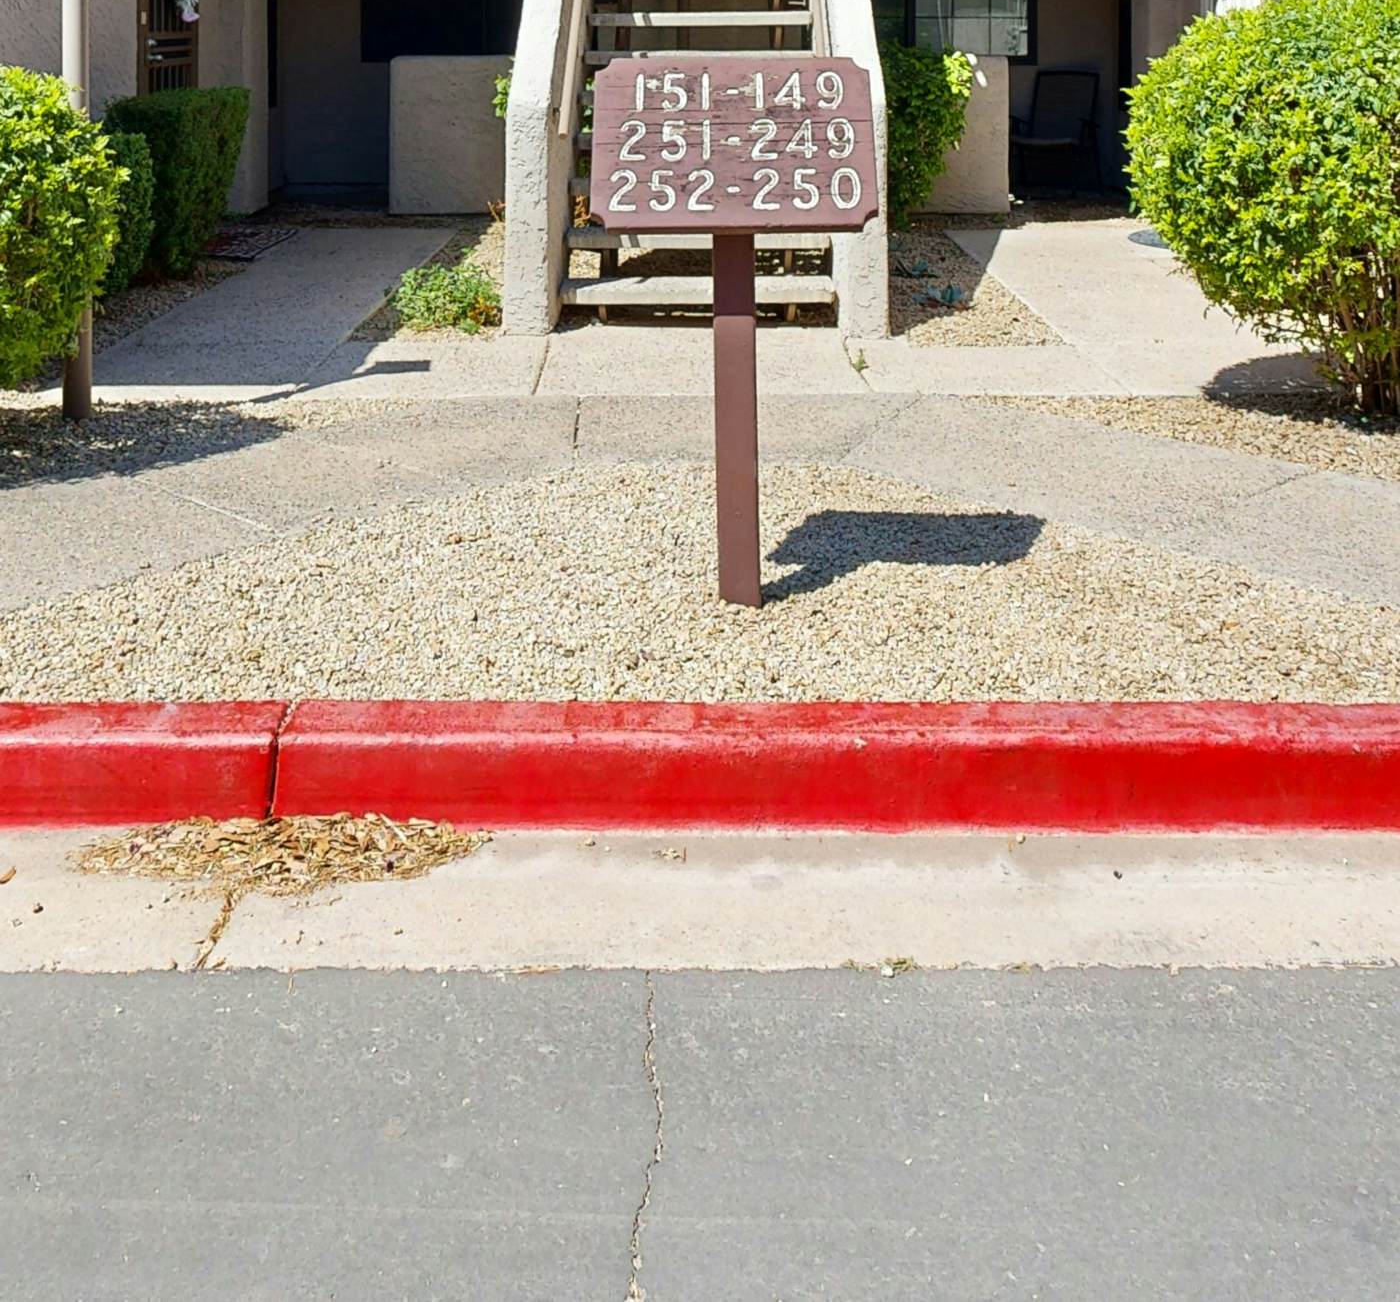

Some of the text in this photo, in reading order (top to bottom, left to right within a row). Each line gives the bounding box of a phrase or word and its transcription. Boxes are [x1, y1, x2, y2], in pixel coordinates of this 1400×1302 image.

[634, 71, 844, 112] 151-149
[618, 117, 856, 162] 251-249
[608, 167, 862, 212] 252-250
